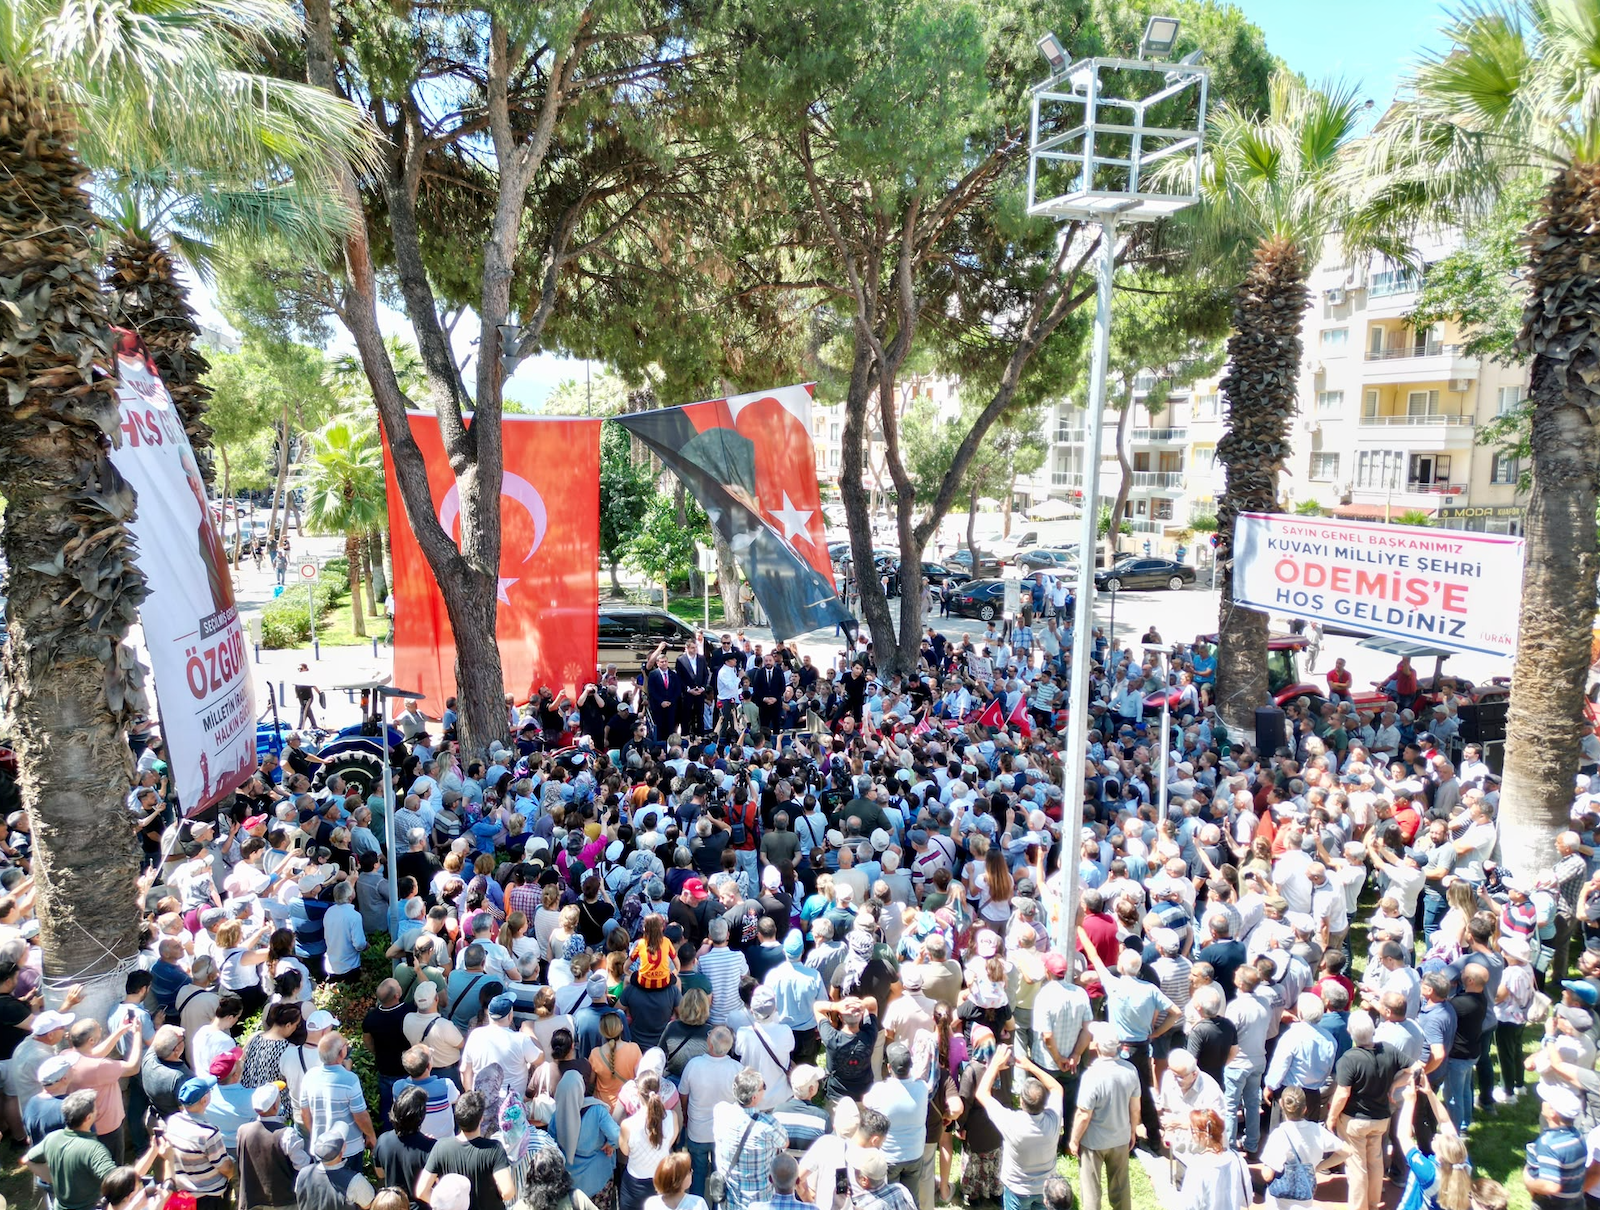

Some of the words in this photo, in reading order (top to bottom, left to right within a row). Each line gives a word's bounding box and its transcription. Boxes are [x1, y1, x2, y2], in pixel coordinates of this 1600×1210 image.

[1454, 507, 1493, 517] MODA
[1497, 507, 1520, 516] KUAFÖR
[1282, 525, 1317, 538] SAYIN
[1321, 530, 1364, 543] GENEL
[1369, 535, 1463, 554] BAŞKANIMIZ
[1268, 538, 1328, 557] KUVAYI
[1335, 546, 1409, 568] MİLLİYE
[1417, 557, 1481, 578] ŞEHRİ
[1274, 553, 1469, 614] ÖDEMİŞ'E
[203, 609, 229, 634] SEÇİLMİŞ
[1276, 587, 1324, 612] HOŞ
[1334, 599, 1466, 638] GELDİNİZ
[185, 626, 245, 699] ÖZGÜR
[202, 698, 235, 733] MİLLETİN
[214, 715, 240, 747] HALKIN
